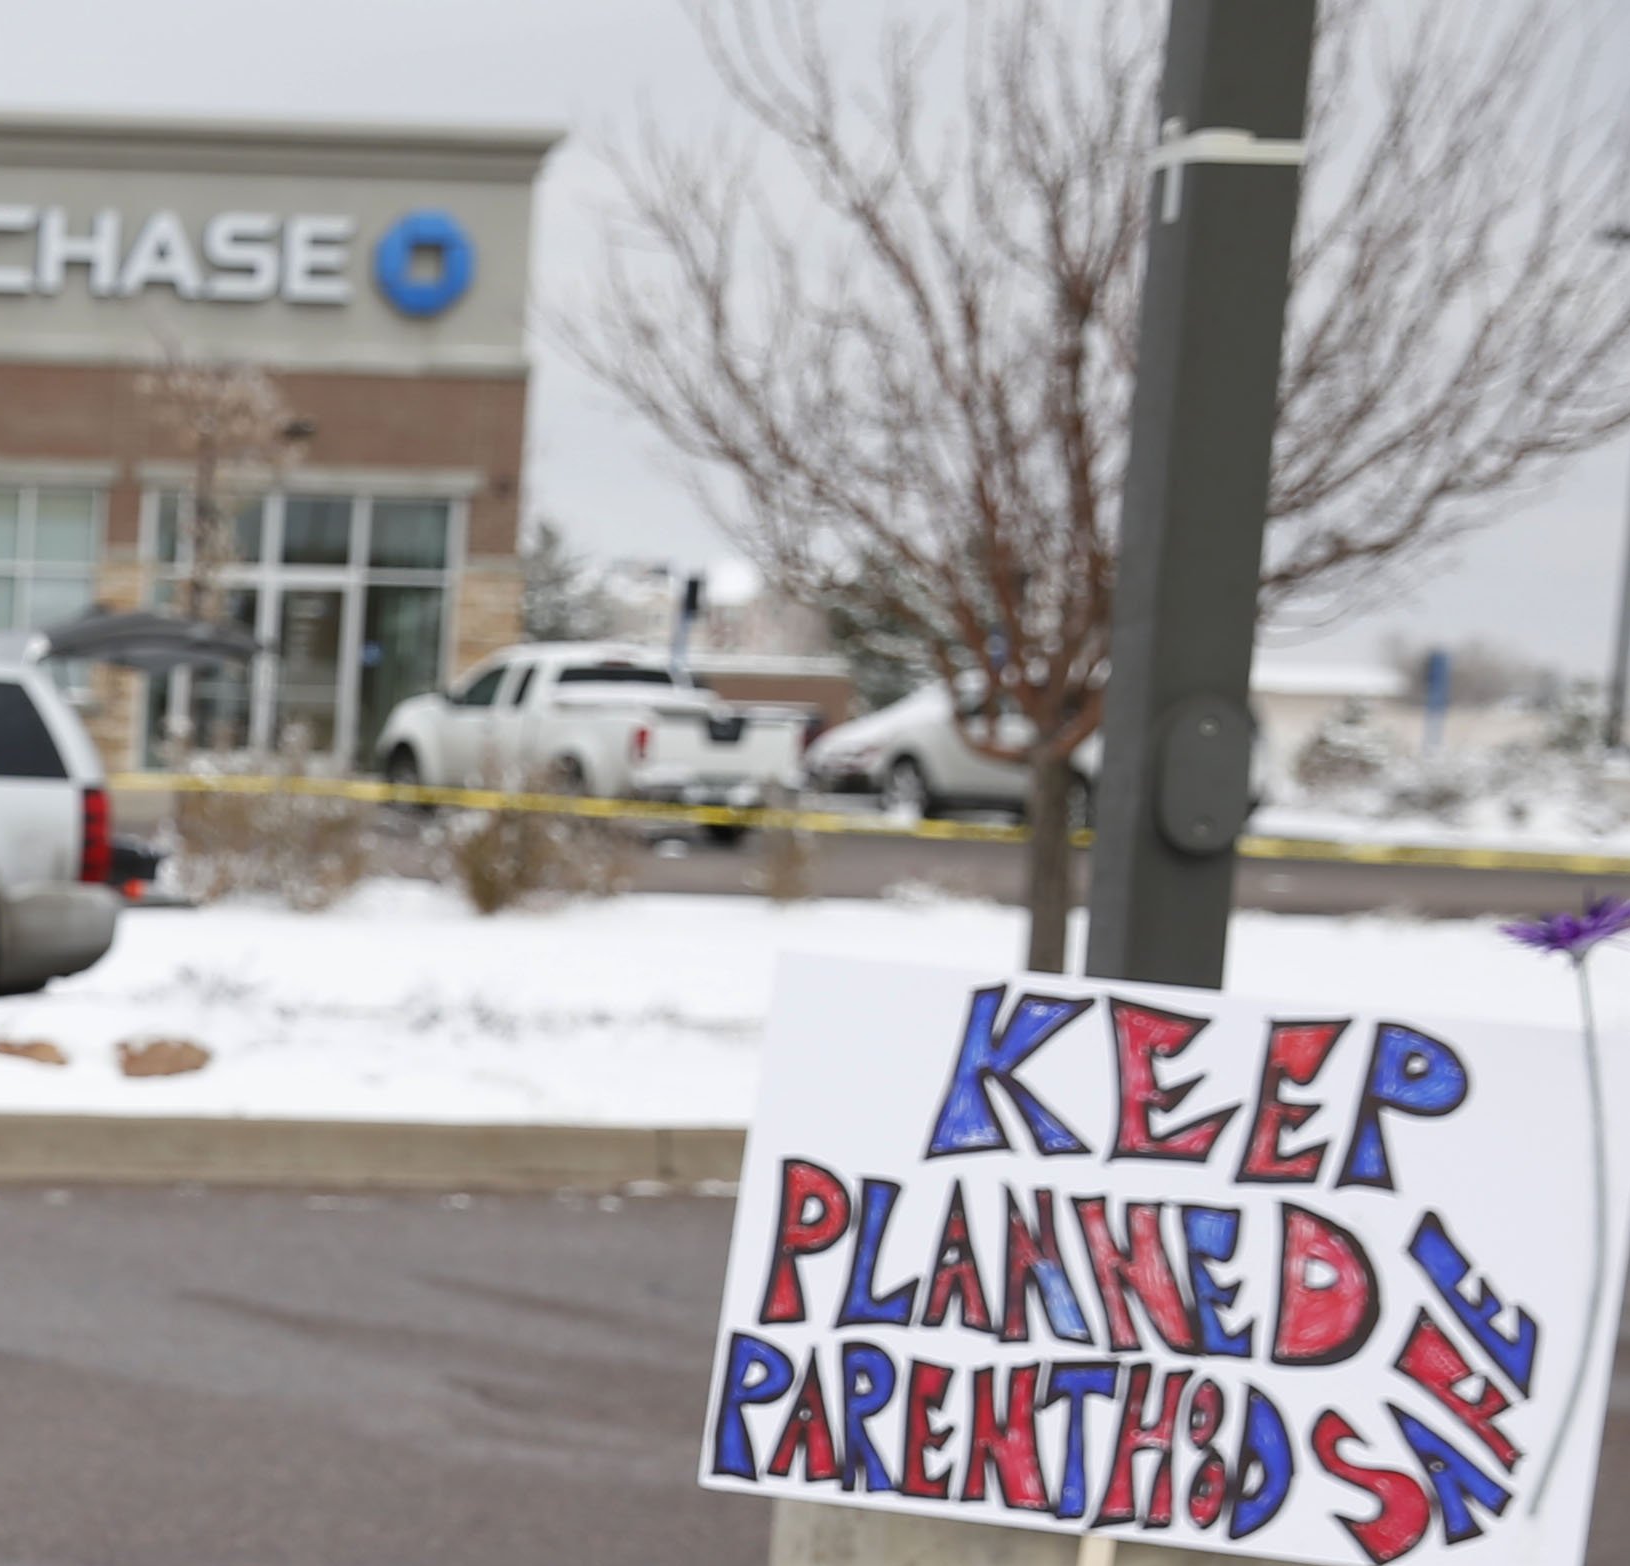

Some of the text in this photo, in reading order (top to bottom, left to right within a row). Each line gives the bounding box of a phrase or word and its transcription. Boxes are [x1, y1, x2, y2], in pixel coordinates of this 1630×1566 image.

[924, 983, 1470, 1192] KEEP
[758, 1157, 1381, 1367] PLANNED
[712, 1210, 1539, 1566] PARENTHOOD SAFE
